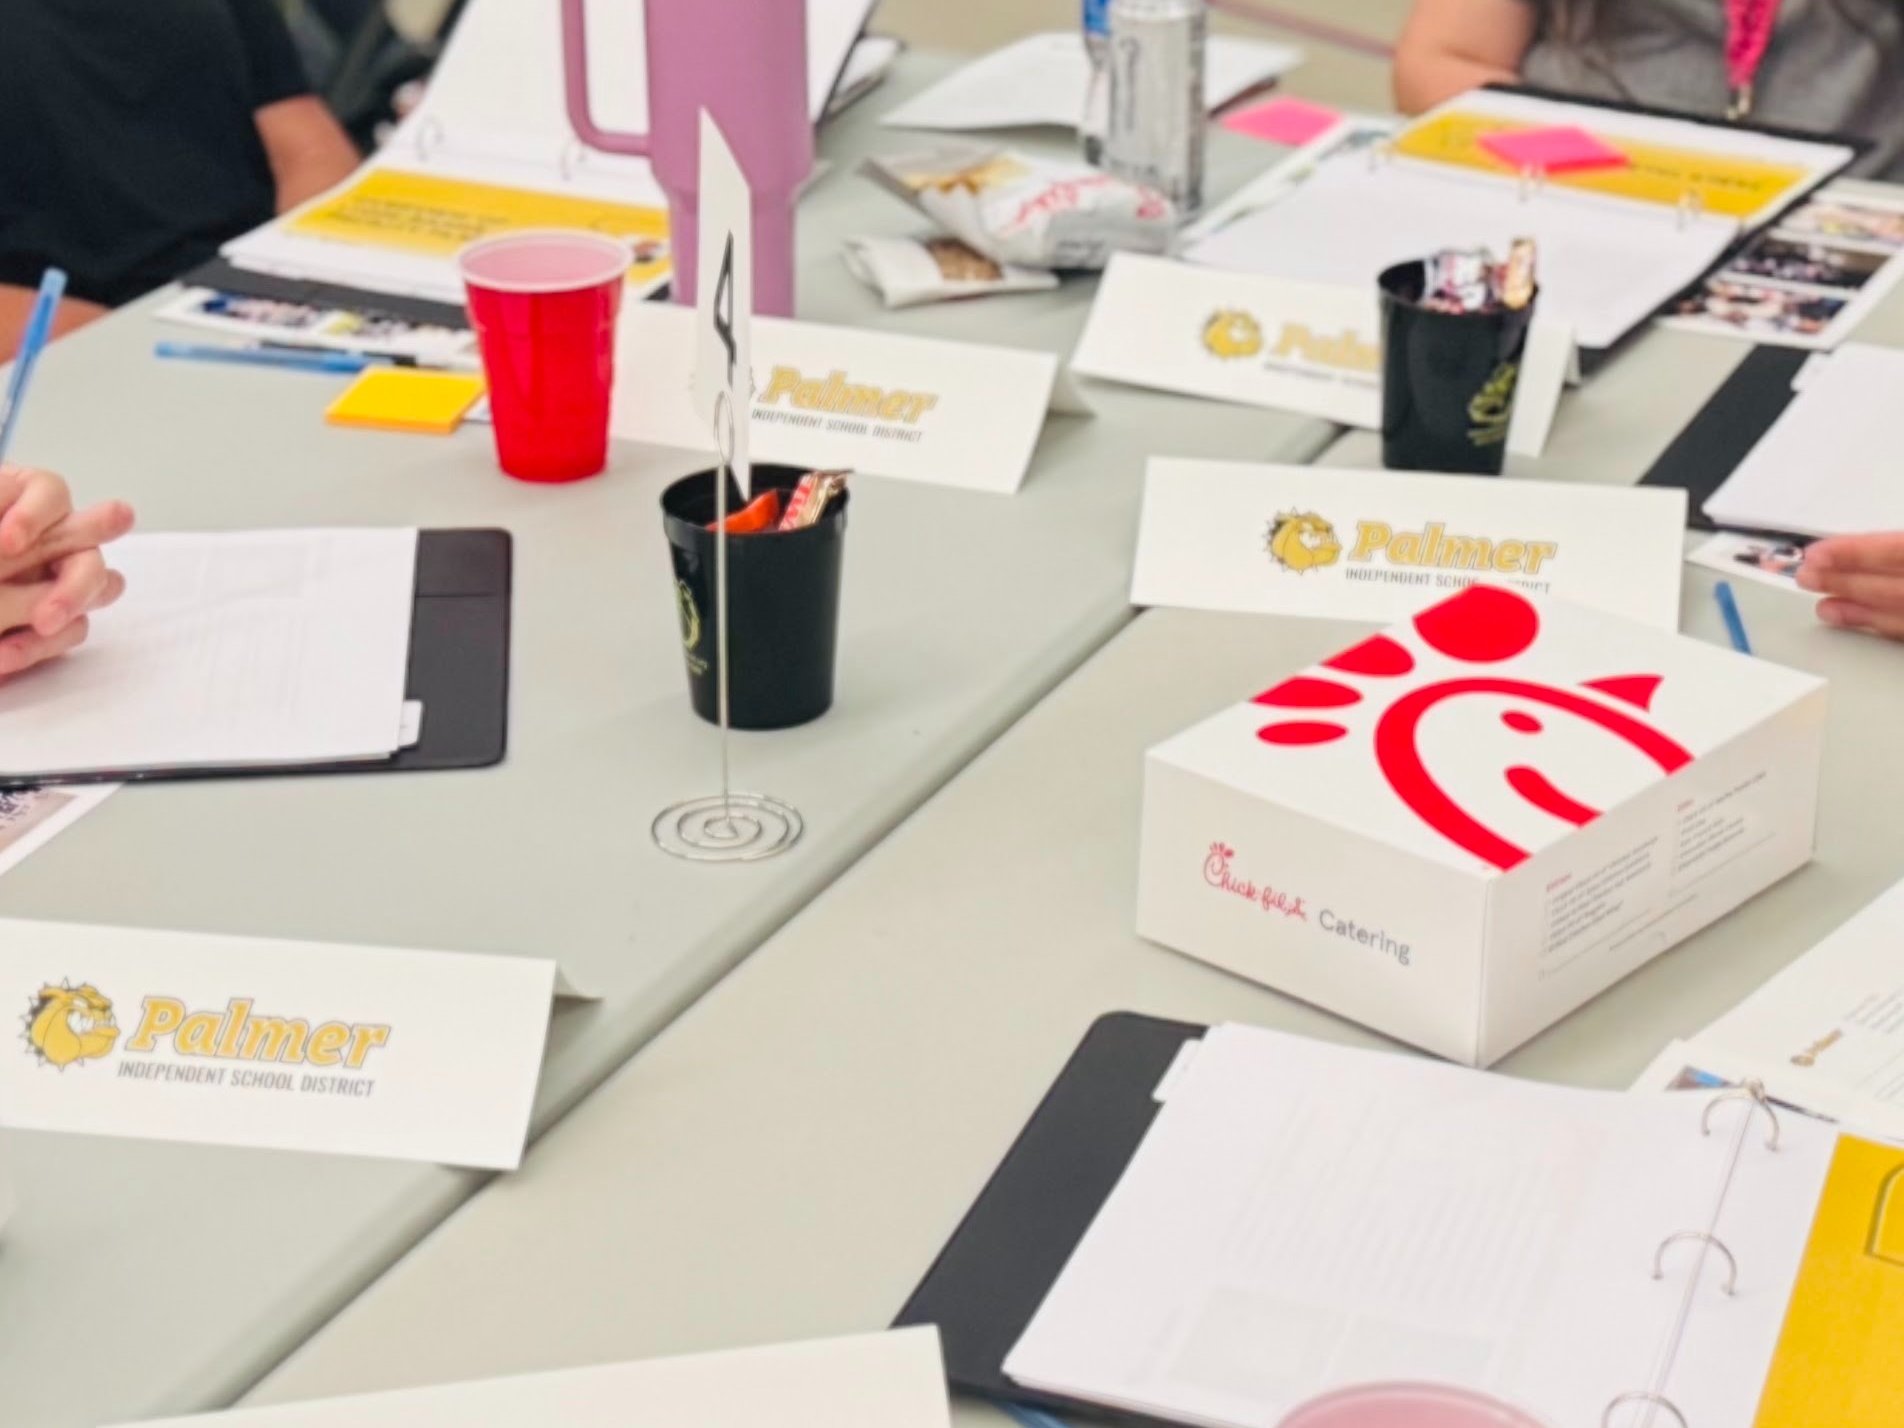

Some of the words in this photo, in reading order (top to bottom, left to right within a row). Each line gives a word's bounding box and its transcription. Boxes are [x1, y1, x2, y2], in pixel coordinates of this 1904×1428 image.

[758, 365, 938, 424] Palmer
[752, 408, 822, 429] INDEPENDENT
[826, 418, 867, 434] SCHOOL
[872, 424, 923, 443] DISTRICT
[1348, 520, 1558, 575] Palmer
[1346, 567, 1430, 585] INDEPENDENT
[1320, 909, 1410, 966] Catering
[124, 996, 391, 1069] Palmer
[118, 1061, 227, 1086] INDEPENDENT
[230, 1069, 295, 1092] SCHOOL
[301, 1075, 375, 1099] DISTRICT
